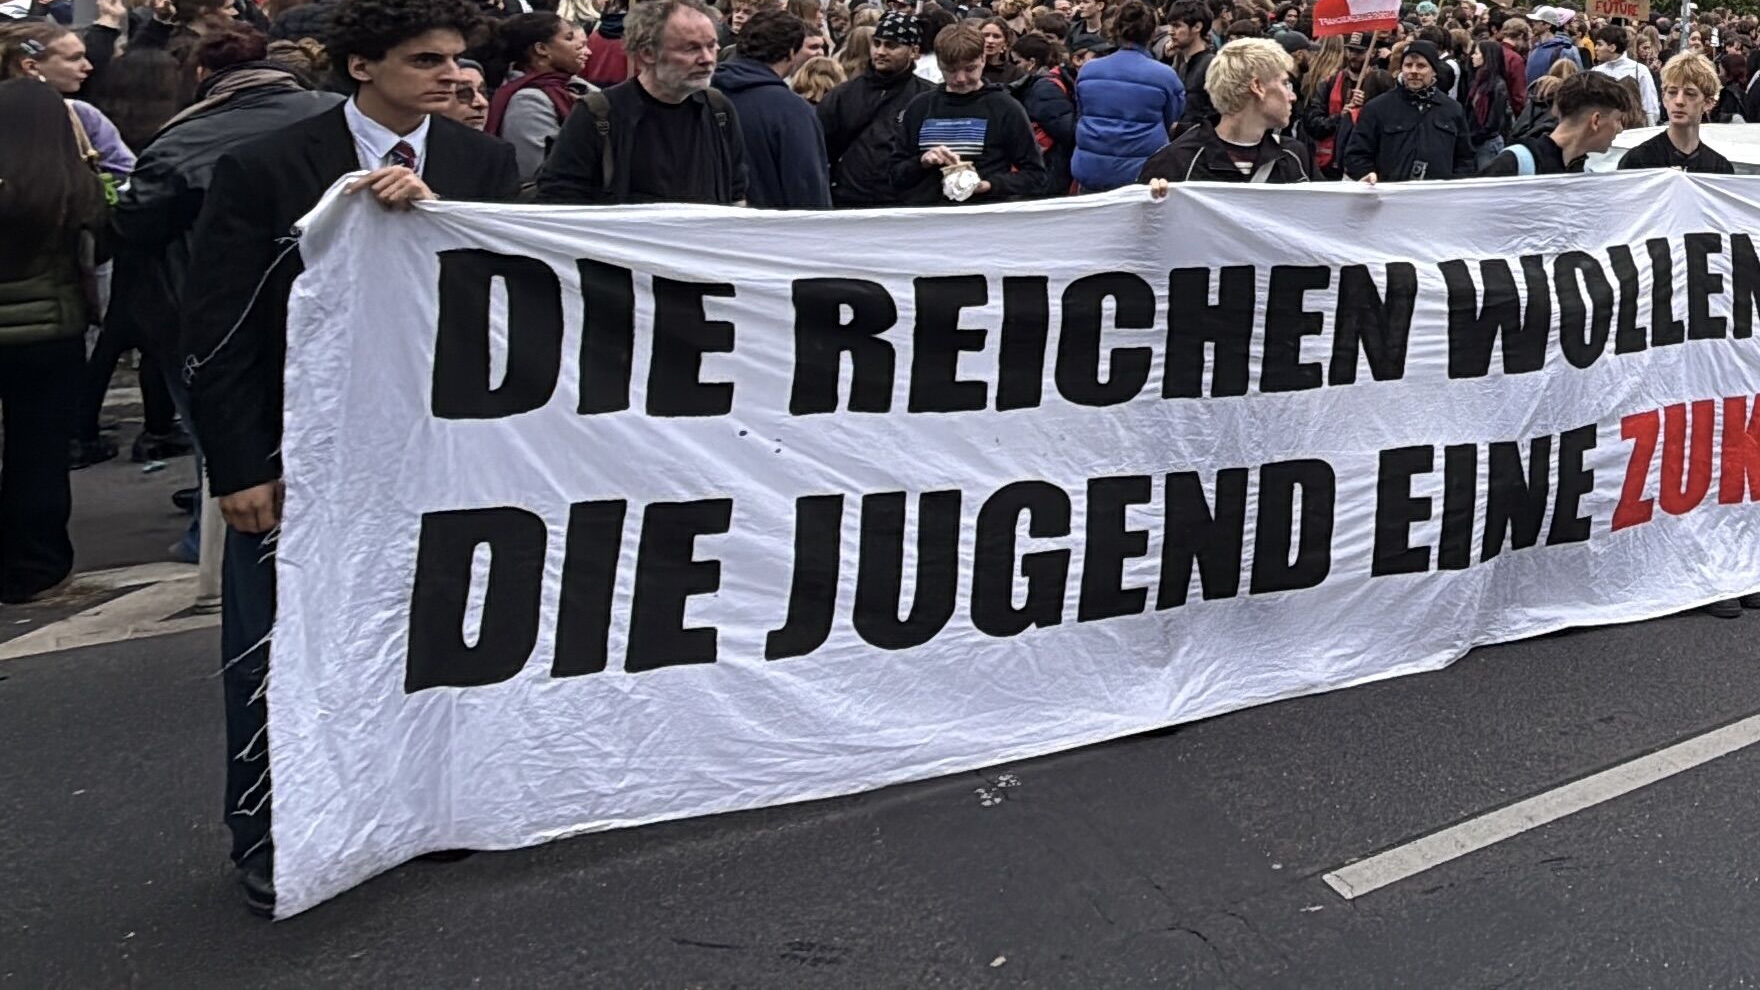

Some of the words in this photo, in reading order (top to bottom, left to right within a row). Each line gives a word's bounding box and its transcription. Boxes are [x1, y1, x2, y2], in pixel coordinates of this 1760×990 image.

[1595, 0, 1639, 17] FUTURE
[432, 248, 736, 419] DIE
[790, 260, 1418, 415] REICHEN
[404, 498, 733, 694] DIE
[765, 458, 1335, 661] JUGEND
[1370, 426, 1597, 577] EINE
